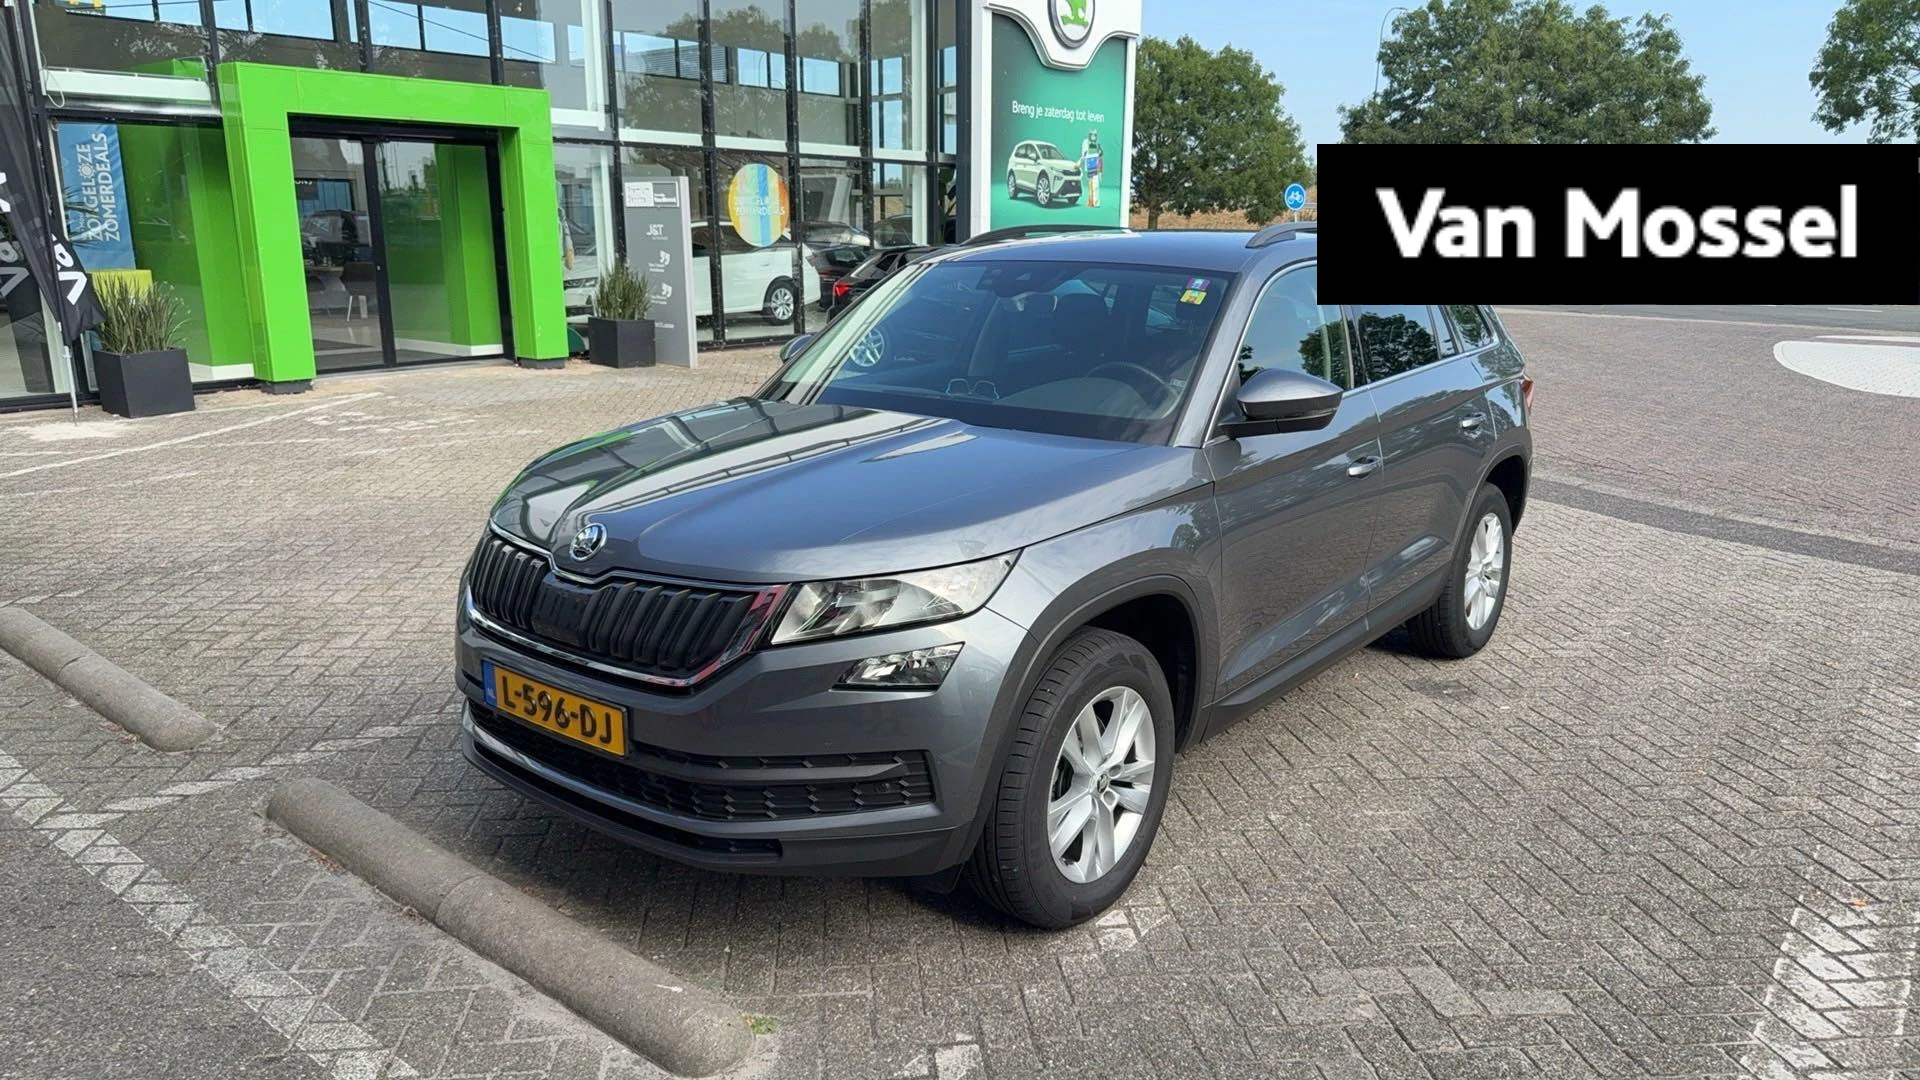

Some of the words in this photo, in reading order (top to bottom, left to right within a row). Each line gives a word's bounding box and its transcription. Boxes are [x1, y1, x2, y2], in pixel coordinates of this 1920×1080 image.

[1012, 100, 1034, 118] Breng
[1035, 103, 1043, 119] je
[1044, 106, 1074, 123] zaterdag
[1076, 109, 1086, 121] tot
[1087, 110, 1104, 123] leven
[91, 132, 121, 242] ZOMERDEALS
[502, 676, 612, 744] L-596-DJ
